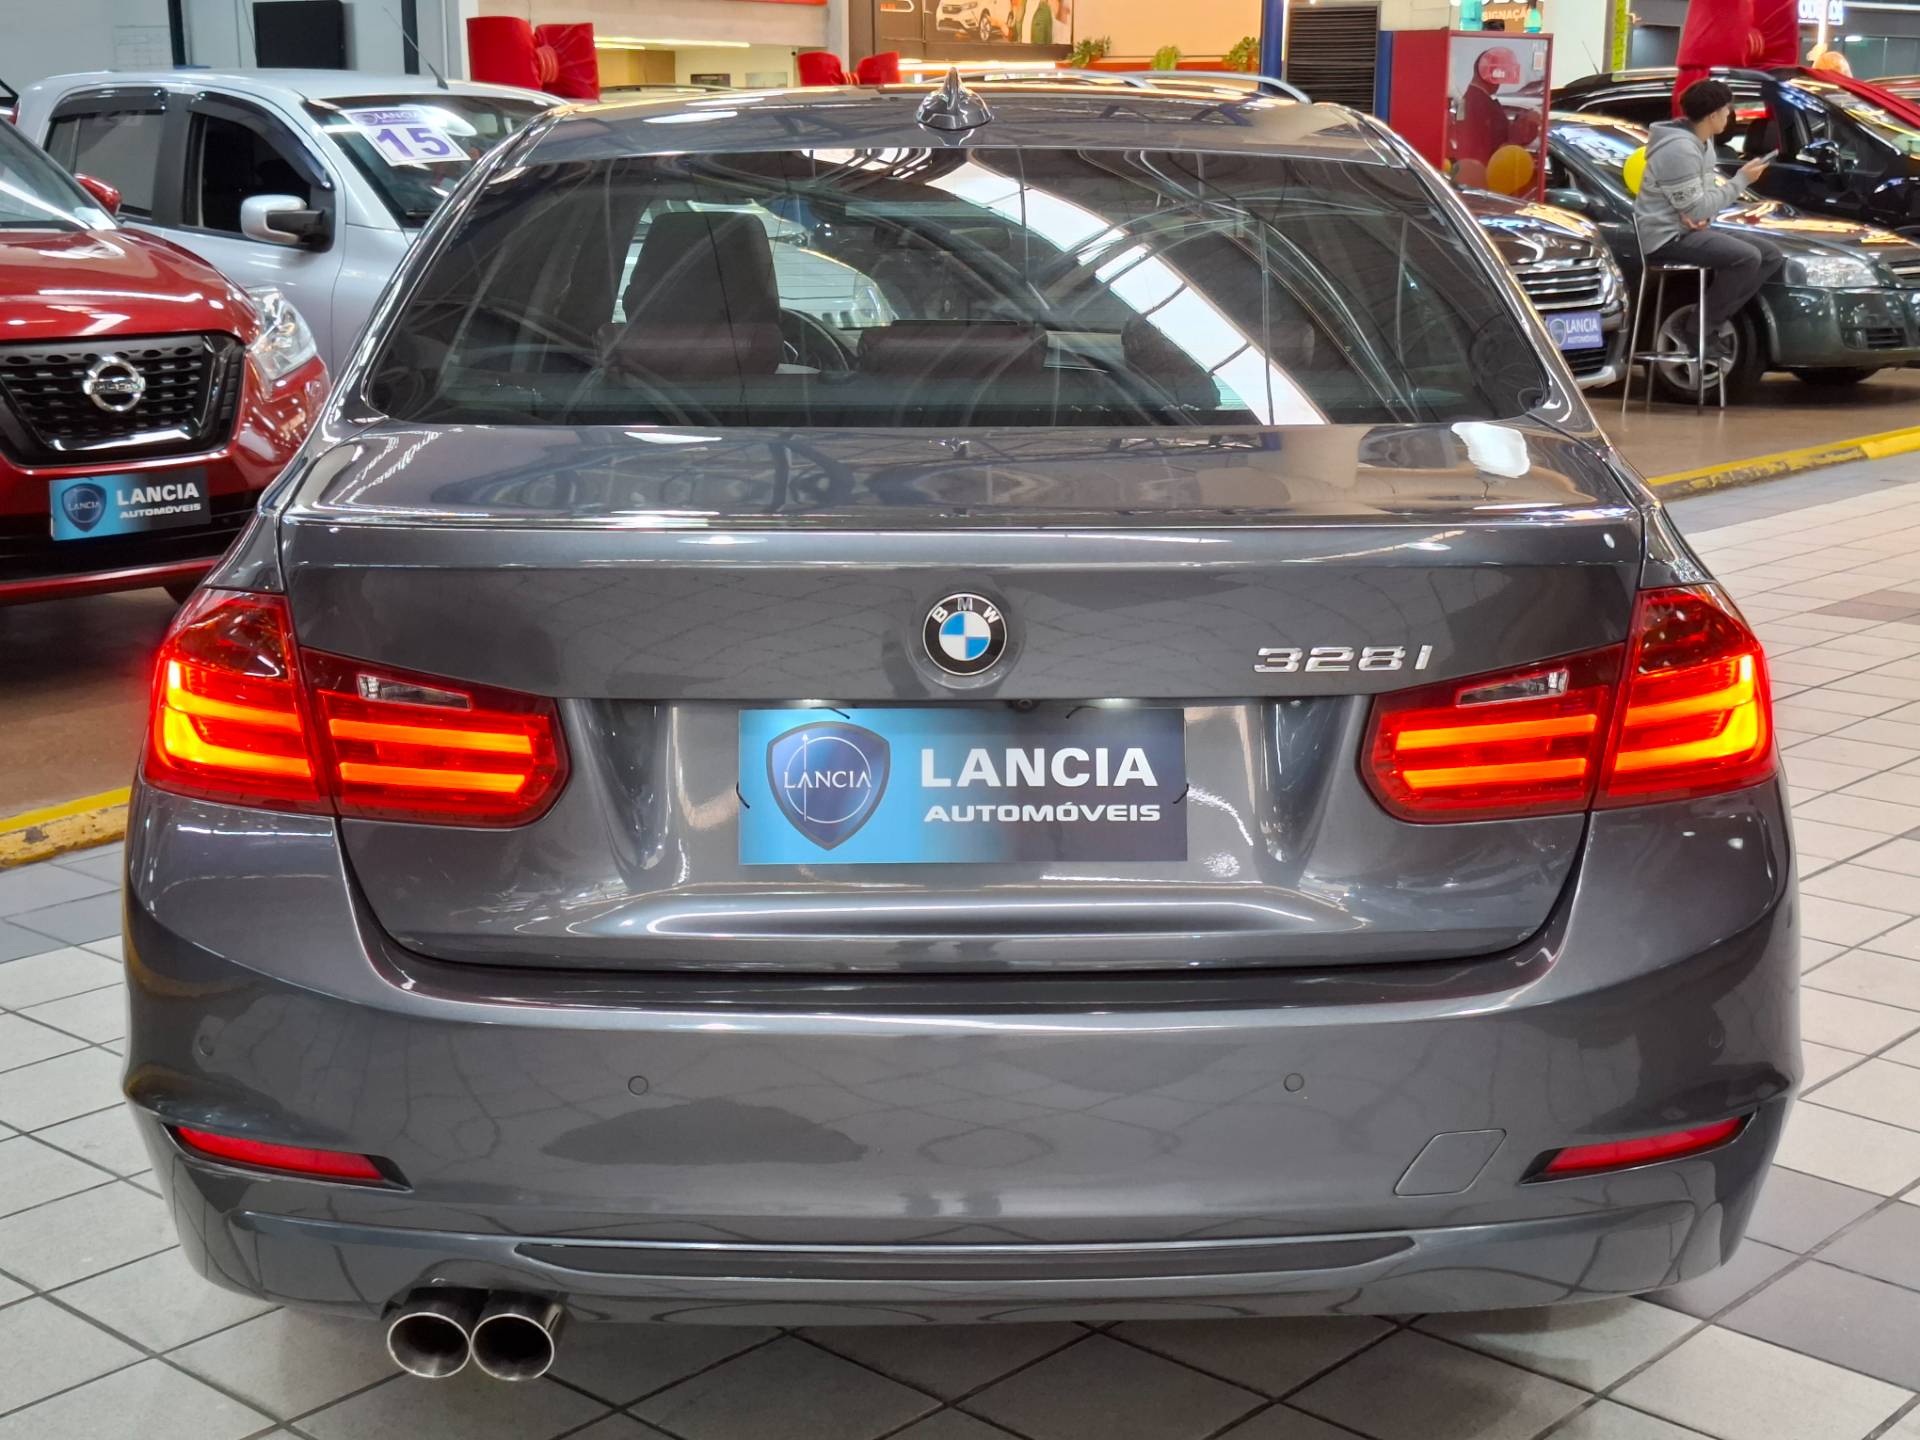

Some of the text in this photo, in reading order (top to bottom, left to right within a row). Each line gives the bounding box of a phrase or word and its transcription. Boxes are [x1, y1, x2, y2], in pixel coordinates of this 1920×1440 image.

[377, 127, 451, 158] 15
[116, 482, 200, 506] LANCIA
[931, 597, 1000, 624] BMW
[783, 770, 873, 789] LANCIA
[921, 747, 1159, 787] LANCIA
[923, 802, 1161, 823] AUTOMÓVEIS
